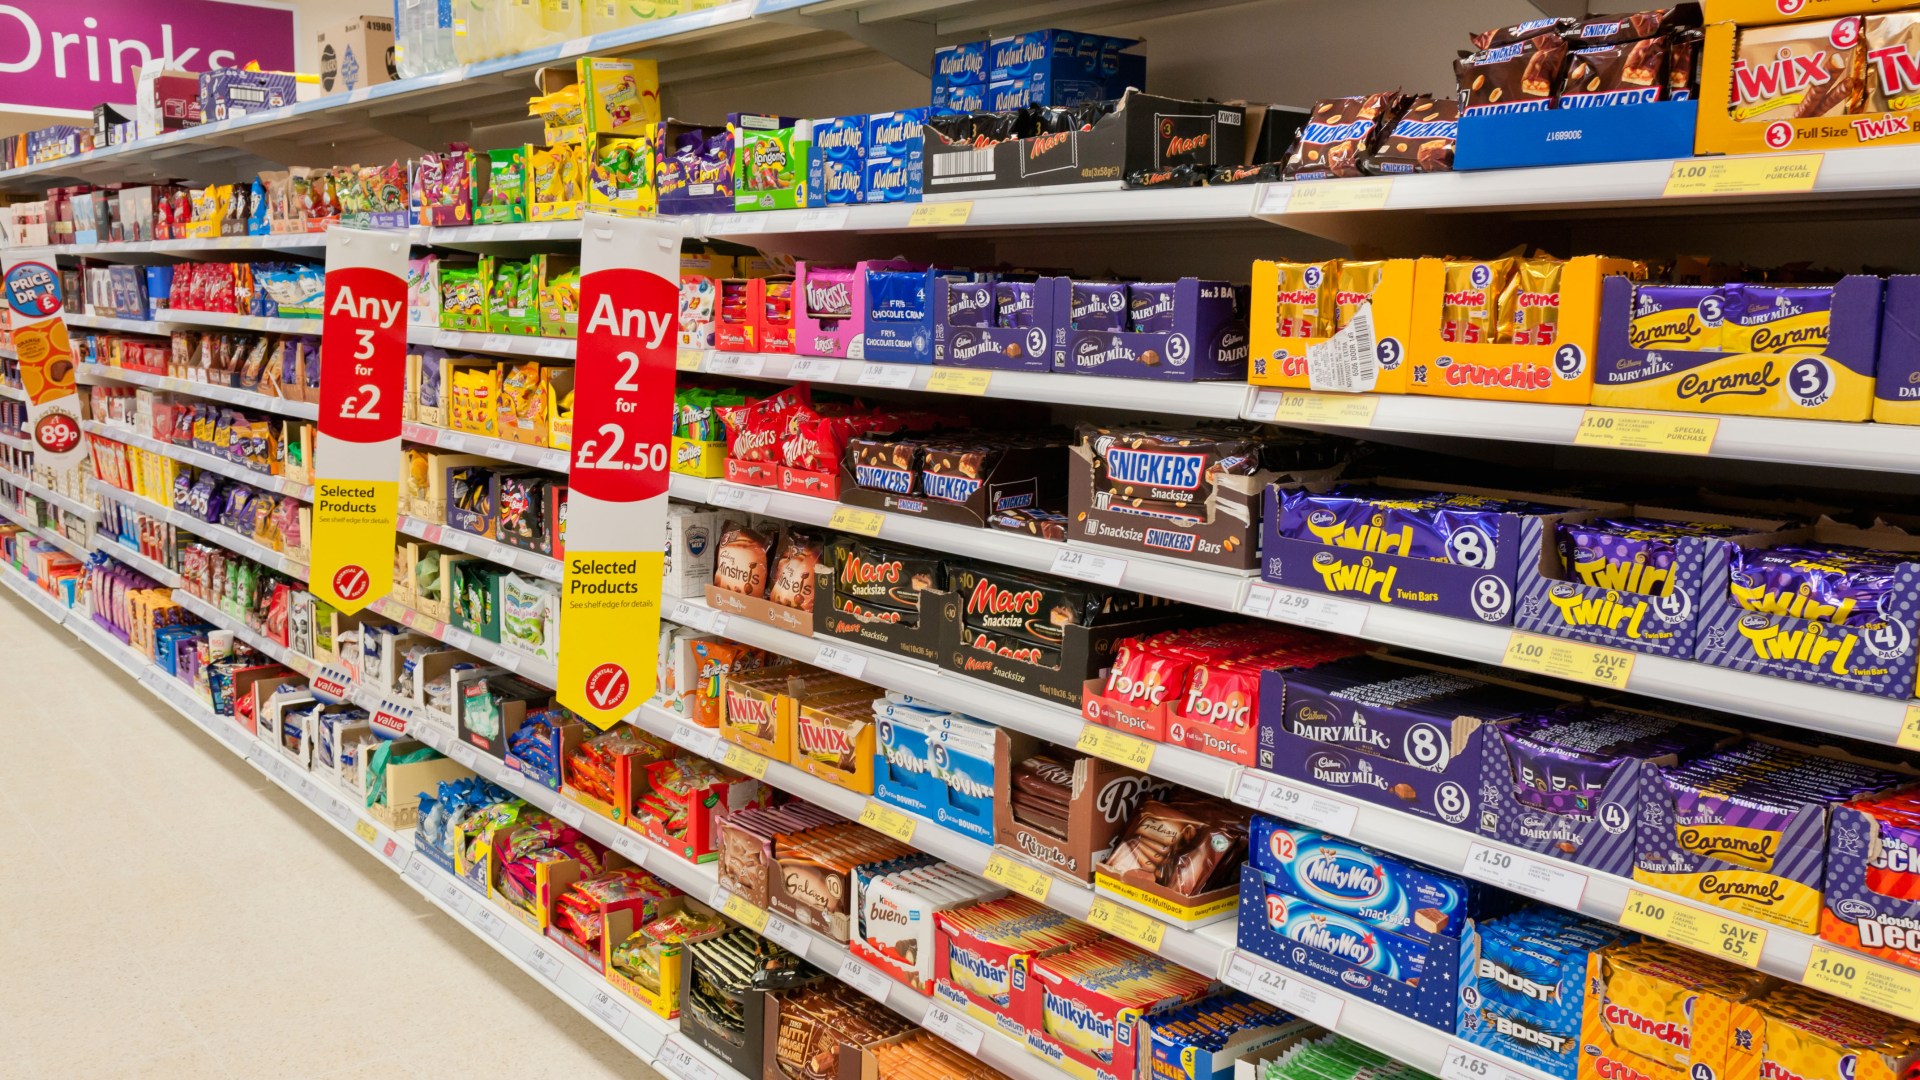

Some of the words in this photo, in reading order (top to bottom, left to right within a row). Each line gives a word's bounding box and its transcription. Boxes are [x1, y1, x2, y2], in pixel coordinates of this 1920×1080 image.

[366, 21, 392, 32] 41980
[1487, 43, 1523, 61] SNICKERS
[940, 58, 962, 75] Walnut
[964, 53, 984, 73] Whip
[1219, 112, 1240, 124] XW188
[818, 128, 843, 150] Walnut
[843, 125, 862, 150] Whip
[1303, 119, 1374, 144] NICKERS
[1547, 128, 1582, 142] 30068917
[1771, 124, 1788, 146] 3
[1796, 128, 1818, 140] Full
[1821, 125, 1848, 138] Size
[1853, 114, 1910, 142] Twix
[1165, 133, 1210, 158] Mars
[754, 149, 787, 169] Randoms
[1382, 163, 1414, 173] SNICKERS
[1773, 164, 1808, 173] SPECIAL
[842, 170, 861, 196] Whip
[1671, 166, 1707, 179] £1.00
[1765, 171, 1811, 180] PURCHASE
[10, 272, 50, 292] PRICE
[330, 285, 402, 329] Any
[1707, 298, 1722, 320] 3
[586, 293, 672, 350] Any
[353, 328, 375, 360] 3
[866, 338, 895, 348] CHOCOLATE
[895, 340, 912, 349] CREAM
[954, 344, 978, 360] DAIRY
[978, 338, 1002, 354] MILK
[1381, 341, 1396, 363] 3
[1077, 352, 1105, 367] DAIRY
[1105, 346, 1135, 362] MILK
[1559, 347, 1576, 371] 3
[1616, 358, 1642, 370] Cadbury
[354, 363, 374, 377] for
[614, 351, 640, 392] 2
[1445, 361, 1552, 391] Crunchie
[1608, 370, 1649, 382] DAIRY
[1650, 360, 1674, 374] MILK
[1677, 361, 1781, 400] Caramel
[1799, 363, 1820, 394] 3
[339, 384, 381, 420] £2
[615, 397, 637, 413] for
[1801, 392, 1829, 407] PACK
[40, 422, 78, 444] 89p
[1580, 417, 1614, 429] £1.00
[1674, 426, 1706, 435] SPECIAL
[575, 423, 668, 472] £2.50
[1667, 433, 1708, 443] PURCHASE
[677, 444, 703, 464] Skittles
[857, 466, 913, 494] SNICKERS
[1108, 449, 1202, 489] SNICKERS
[320, 485, 375, 499] Selected
[997, 494, 1033, 510] SNICKERS
[1151, 488, 1194, 502] Snacksize
[319, 500, 377, 514] Products
[346, 517, 361, 525] edge
[369, 517, 390, 525] details
[1087, 519, 1097, 534] 10
[1099, 524, 1144, 542] Snacksize
[1146, 531, 1195, 551] SNICKERS
[1198, 538, 1222, 554] Bars
[335, 568, 357, 585] ESSENTIAL
[571, 559, 637, 575] Selected
[841, 552, 903, 584] Mars
[351, 580, 367, 597] SAVINGS
[570, 580, 638, 595] Products
[852, 584, 887, 596] Snacksize
[1313, 555, 1398, 603] Twirl
[1397, 588, 1418, 600] Twin
[1418, 591, 1439, 602] Bars
[569, 600, 583, 609] See
[584, 600, 601, 609] shelf
[601, 601, 619, 609] edge
[620, 600, 630, 608] for
[630, 600, 654, 608] details
[967, 578, 1043, 615] Mars
[1279, 594, 1310, 609] £2.99
[1479, 579, 1500, 609] 8
[982, 614, 1022, 627] Snacksize
[1549, 590, 1649, 639] Twirl
[835, 621, 861, 634] Mars
[860, 628, 889, 643] Snacksize
[1511, 642, 1544, 658] £1.00
[1738, 620, 1859, 676] Twirl
[1853, 667, 1872, 676] Twin
[1872, 667, 1888, 676] Bars
[1878, 647, 1903, 659] PACK
[1592, 653, 1628, 669] SAVE
[590, 667, 614, 690] ESSENTIAL
[1594, 665, 1618, 681] 65p
[316, 678, 343, 697] value
[608, 683, 626, 705] SAVINGS
[1107, 669, 1164, 705] Topic
[727, 690, 767, 724] Twix
[1089, 703, 1099, 716] 4
[1116, 710, 1147, 730] Topic
[1188, 689, 1250, 727] Topic
[1300, 706, 1328, 722] Cadbury
[376, 712, 404, 732] value
[800, 717, 849, 754] Twix
[1172, 725, 1182, 739] 4
[1203, 733, 1238, 755] Topic
[1294, 719, 1342, 742] DAIRY
[1342, 718, 1391, 750] MILK
[1413, 728, 1439, 763] 8
[1313, 767, 1351, 784] DAIRY
[1351, 766, 1389, 790] MILK
[897, 794, 919, 809] BOUNTY
[1270, 788, 1300, 803] £2.99
[1442, 785, 1461, 813] 8
[1520, 825, 1551, 840] DAIRY
[1551, 827, 1584, 845] MILK
[1679, 829, 1773, 859] Caramel
[1017, 831, 1066, 865] Ripple
[1273, 836, 1294, 859] 12
[1475, 848, 1512, 869] £1.50
[1699, 875, 1785, 903] Caramel
[879, 895, 898, 911] Kinder
[1141, 893, 1183, 915] 15xMultipack
[1628, 902, 1665, 921] £1.00
[1838, 903, 1874, 917] Cadbury
[870, 906, 908, 926] bueno
[1358, 904, 1411, 928] Snacksize
[1719, 923, 1759, 944] SAVE
[1722, 937, 1749, 958] 65p
[951, 943, 1007, 984] Milkybar
[1294, 951, 1305, 965] 12
[1308, 958, 1339, 978] Snacksize
[1372, 984, 1388, 998] Bars
[1811, 955, 1857, 981] £1.00
[1258, 972, 1287, 991] £2.21
[1478, 957, 1556, 1001] BOOST
[996, 1013, 1024, 1033] Medium
[1047, 992, 1114, 1038] Milkybar
[1495, 1020, 1567, 1053] BOOST
[1453, 1053, 1488, 1077] £1.65
